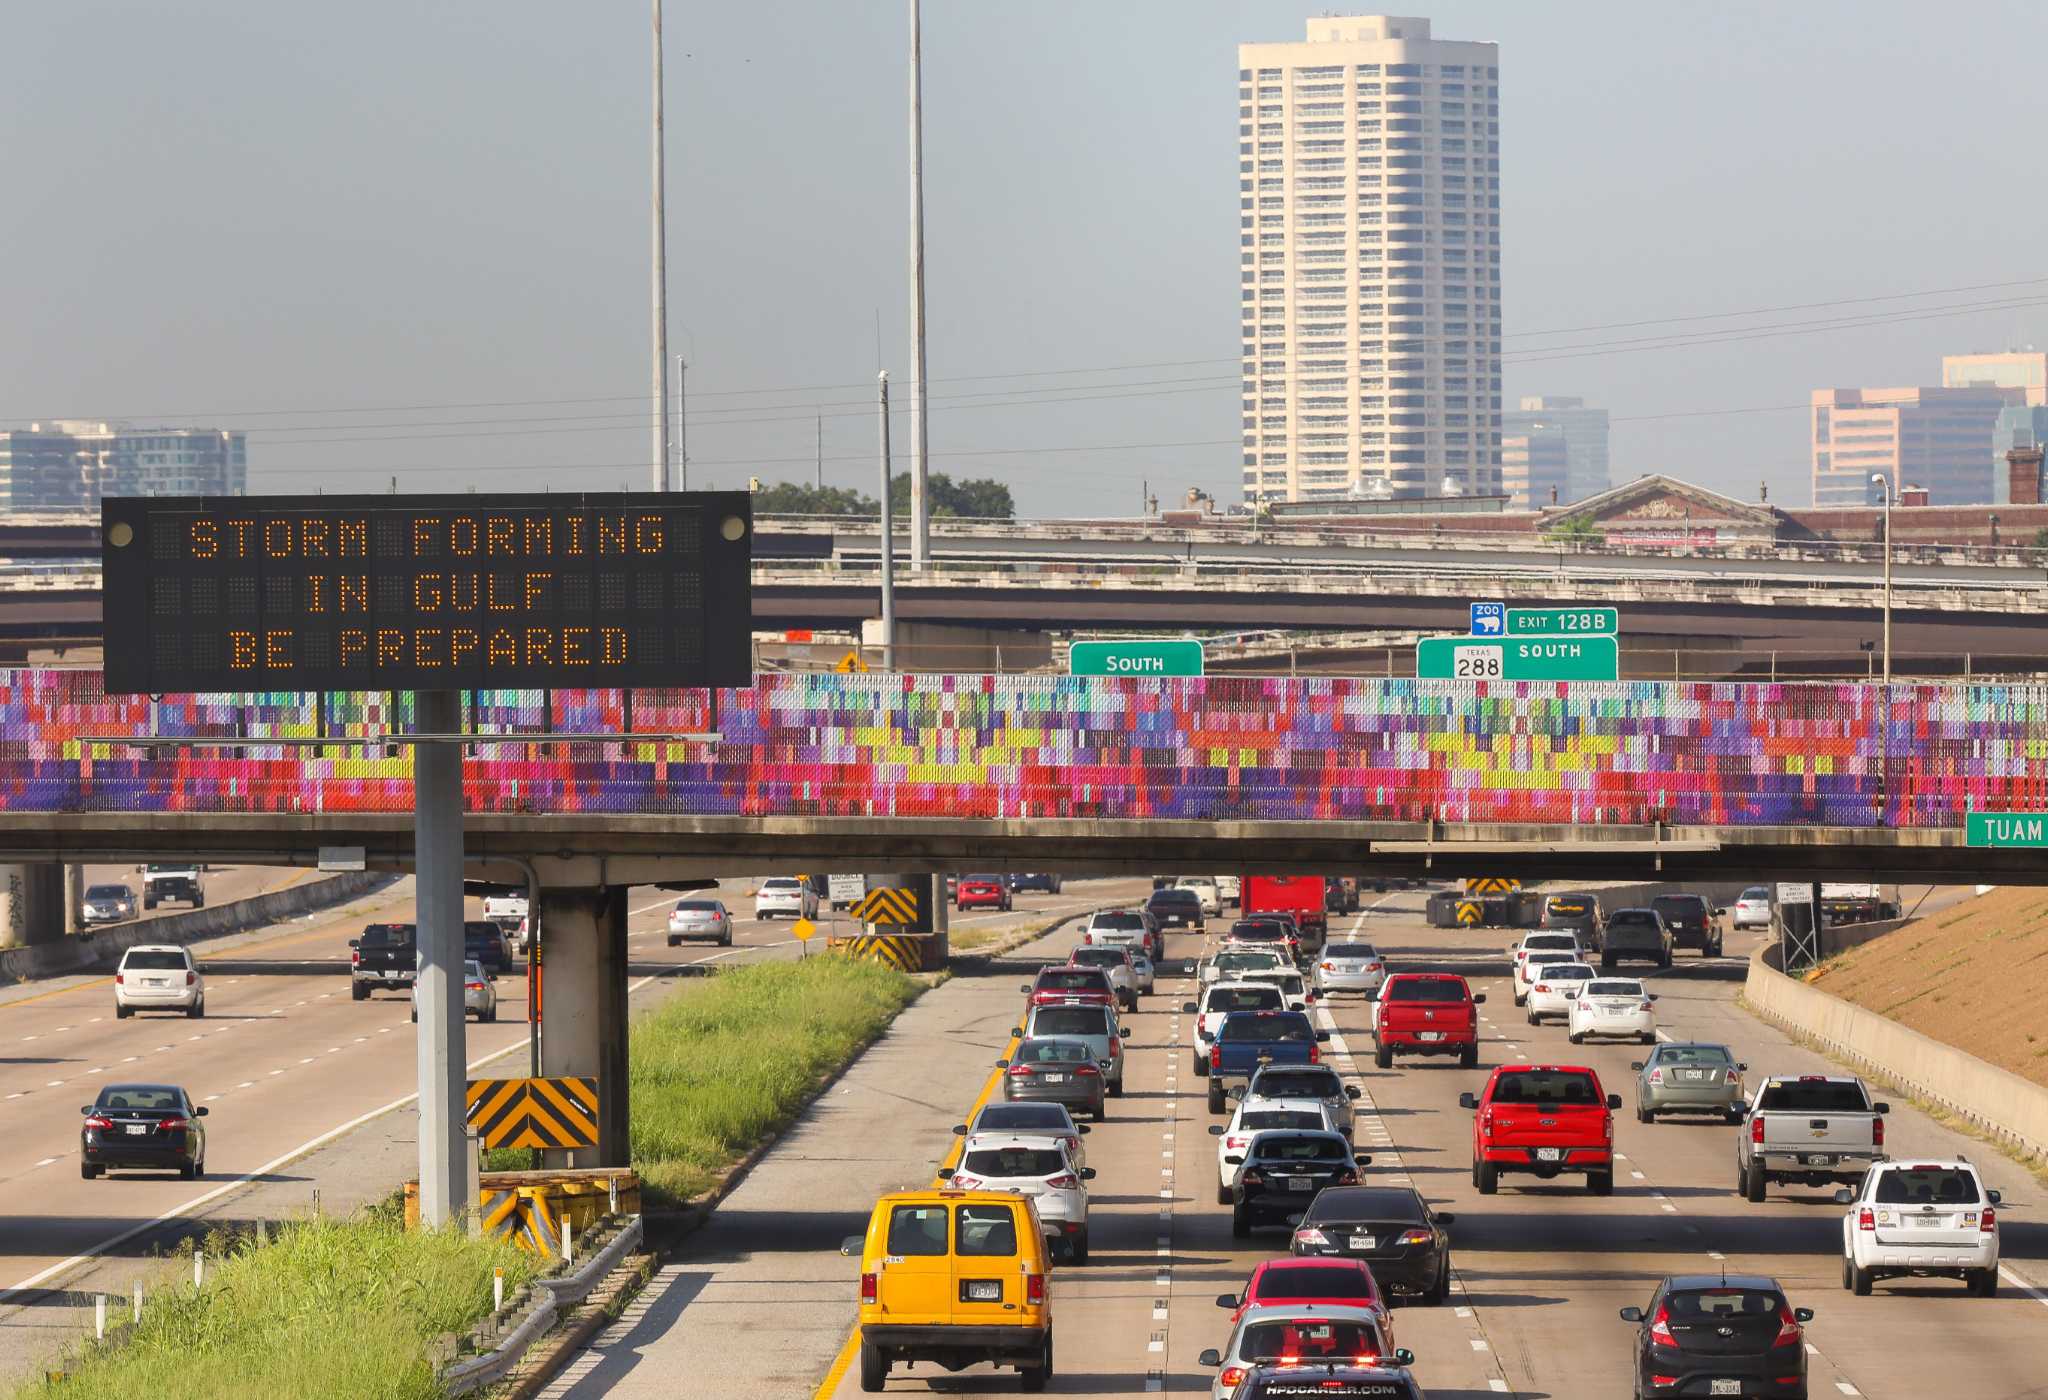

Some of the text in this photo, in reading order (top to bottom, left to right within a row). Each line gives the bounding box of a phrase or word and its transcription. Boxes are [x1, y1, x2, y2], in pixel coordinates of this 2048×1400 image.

[190, 516, 664, 558] STORM FORMING
[309, 573, 552, 613] IN GULF
[1476, 605, 1499, 615] ZOO
[1518, 613, 1606, 630] EXIT 128B
[229, 627, 630, 669] BE PREPARED
[1519, 644, 1582, 658] SOUTH
[1106, 655, 1164, 672] SOUTH
[1458, 658, 1499, 677] 288
[1984, 818, 2043, 841] TUAM
[1266, 1384, 1397, 1395] HPDCAREER.COM
